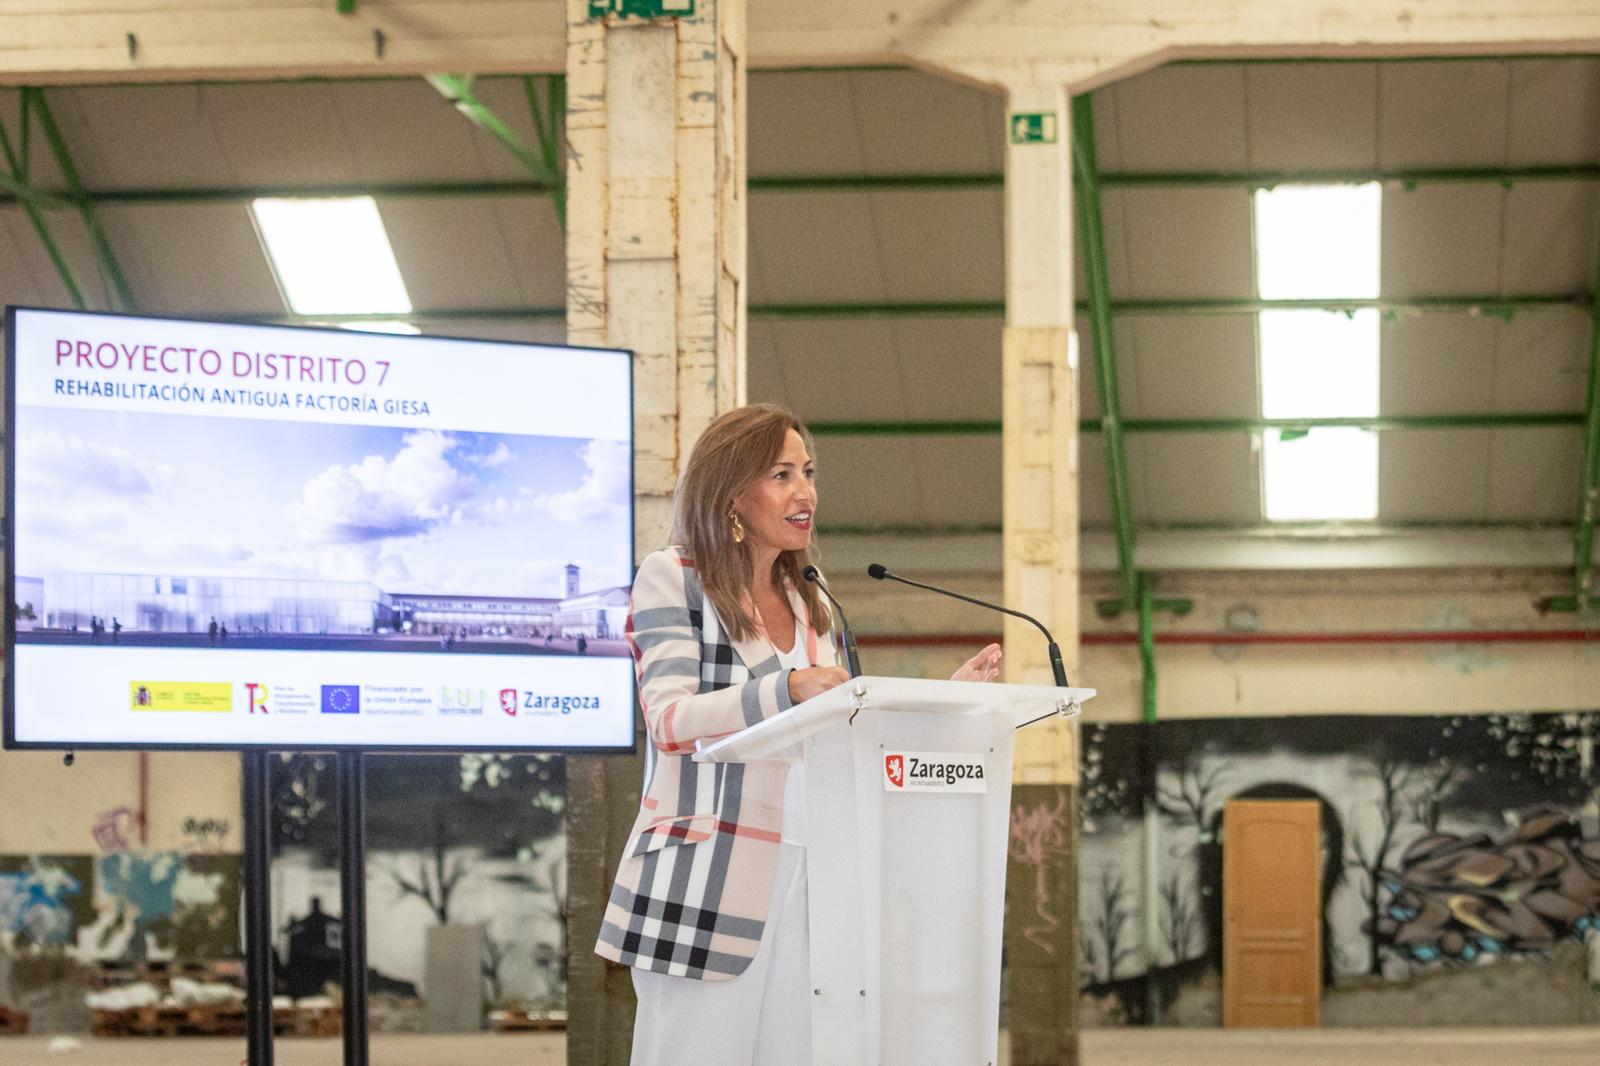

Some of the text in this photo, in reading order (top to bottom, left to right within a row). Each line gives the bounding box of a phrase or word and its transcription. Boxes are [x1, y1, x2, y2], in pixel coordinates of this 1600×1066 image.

[55, 340, 391, 386] PROYECTO DISTRITO 7
[55, 379, 431, 416] REHABILITACIÓN ANTIGUA FACTORÍA GIESA
[524, 691, 600, 714] Zaragoza
[909, 758, 984, 784] Zaragoza
